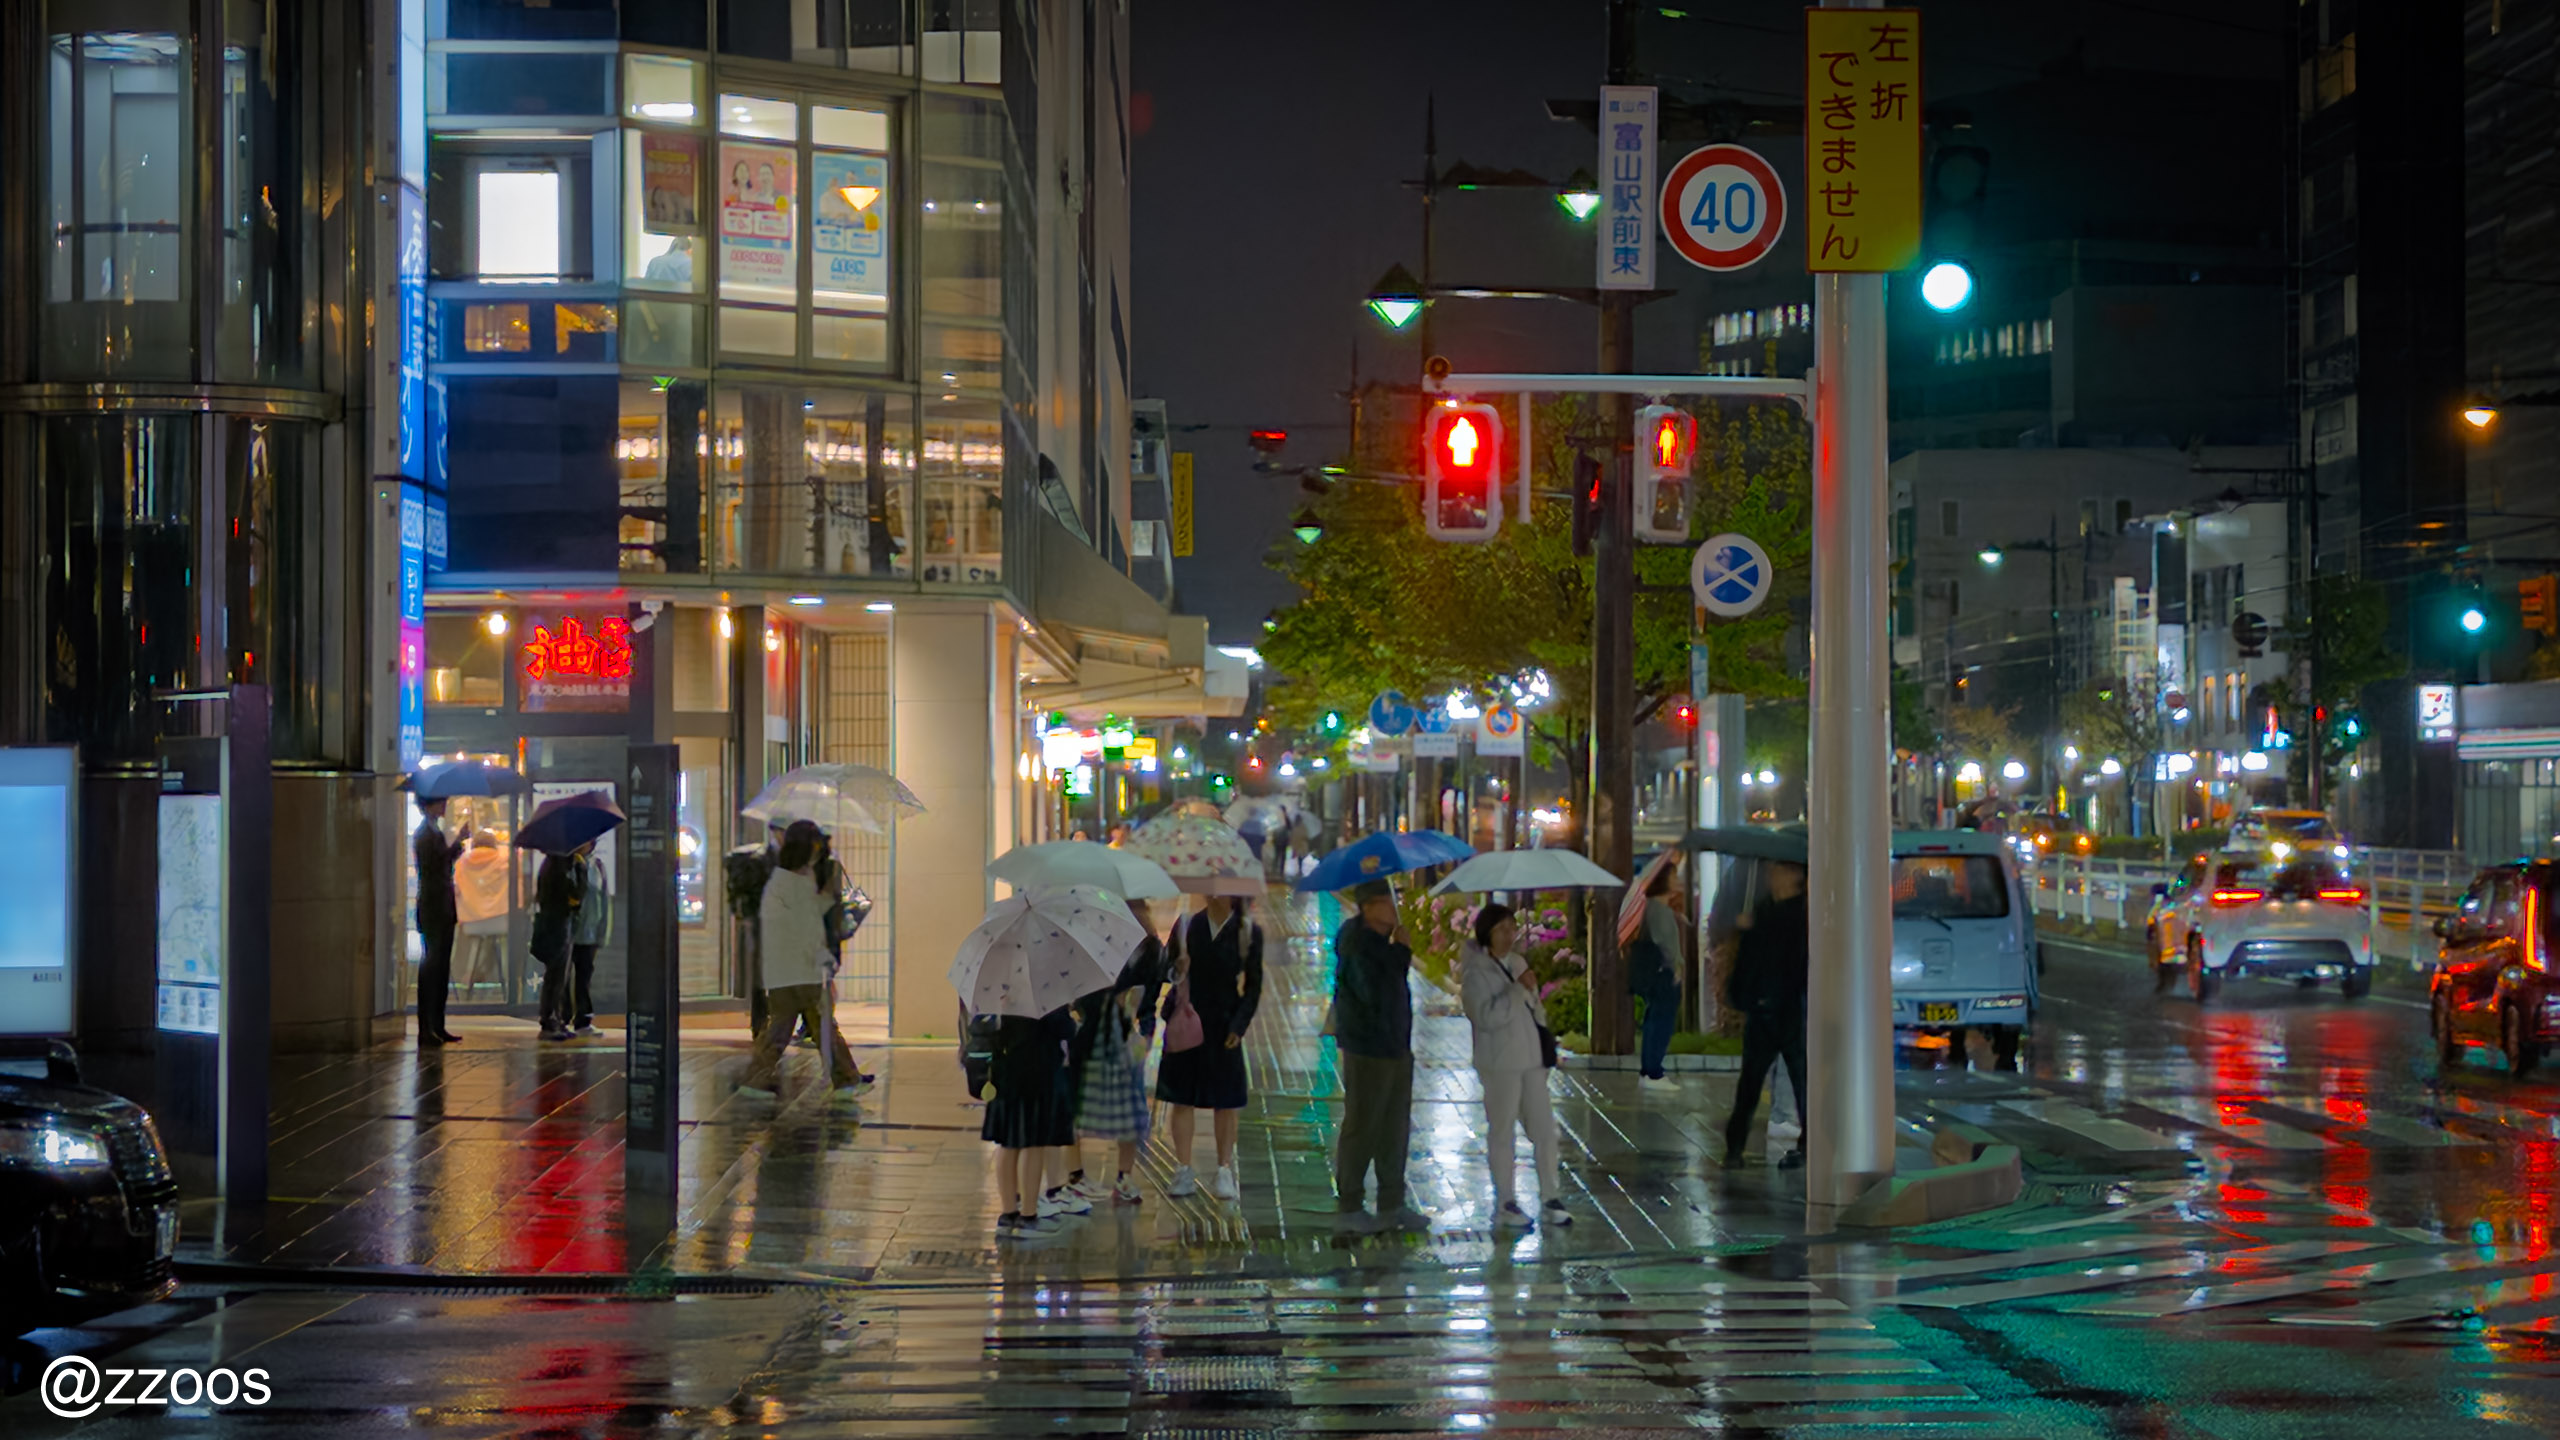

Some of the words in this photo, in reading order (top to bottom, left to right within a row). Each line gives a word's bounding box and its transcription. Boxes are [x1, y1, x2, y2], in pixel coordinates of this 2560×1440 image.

[1868, 23, 1910, 122] 左折
[1611, 121, 1644, 276] 富山駅前東
[1818, 51, 1860, 261] できません
[1690, 181, 1755, 234] 40
[830, 257, 866, 276] AEON
